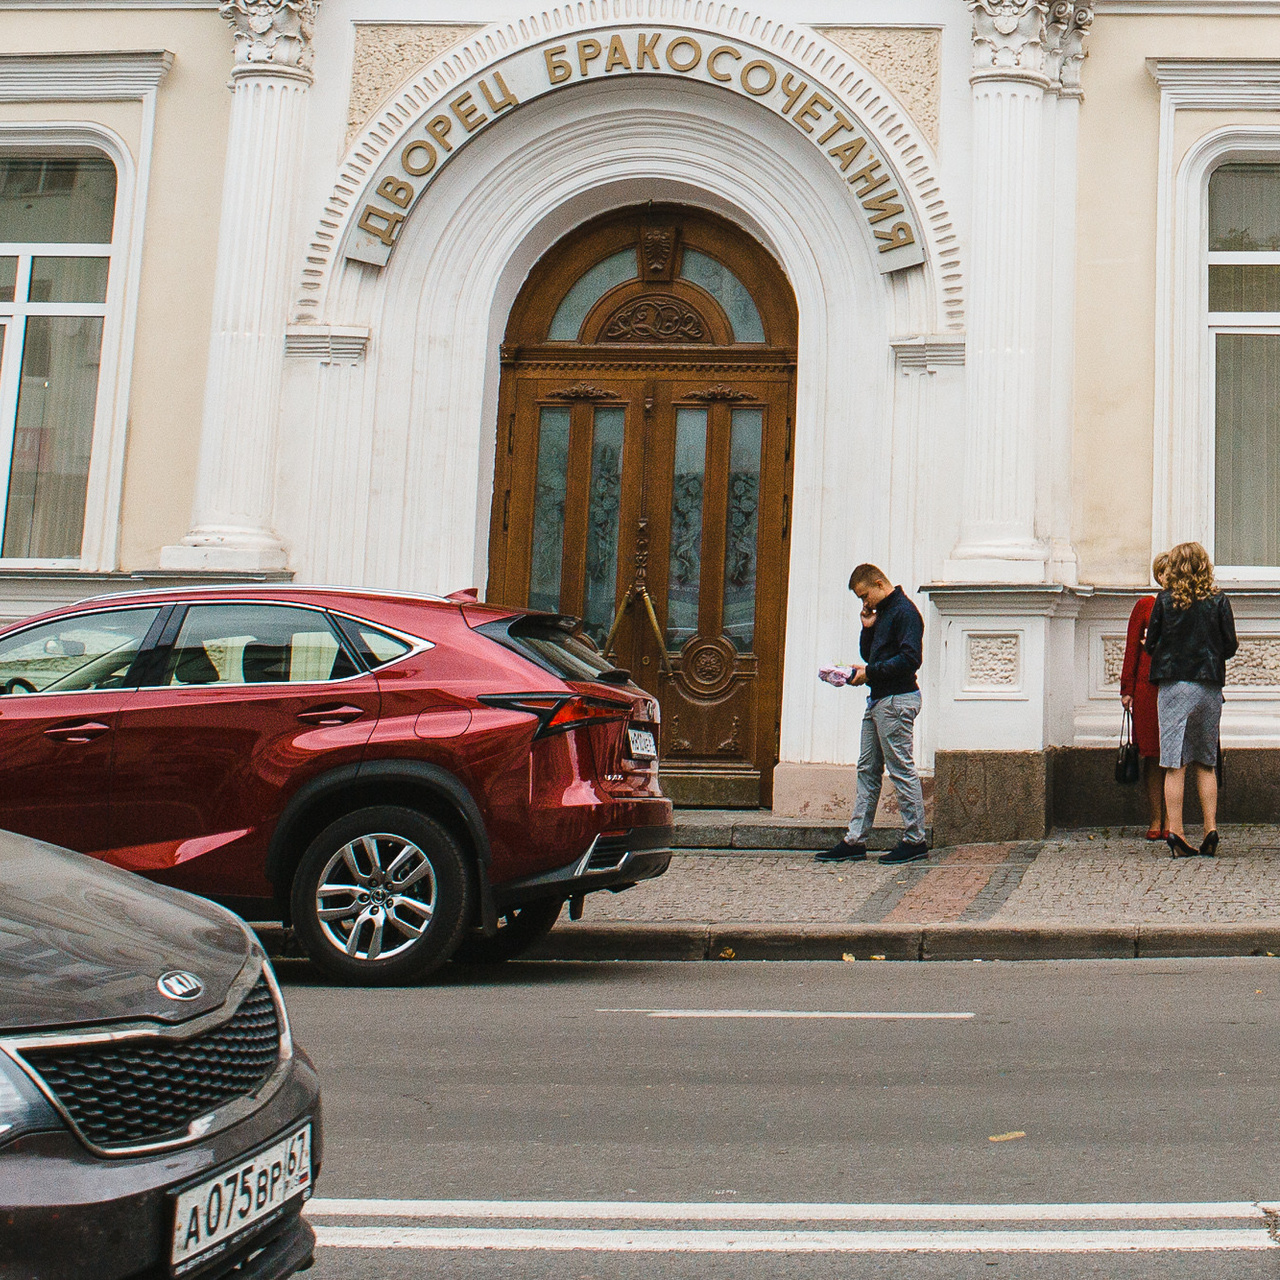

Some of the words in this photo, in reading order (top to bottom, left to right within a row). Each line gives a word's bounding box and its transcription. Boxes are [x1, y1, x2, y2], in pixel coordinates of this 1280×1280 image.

[357, 70, 519, 246] ДВОРЕЦ
[544, 32, 915, 253] БРАКОСОЧЕТАНИЯ
[163, 974, 202, 995] KIA
[287, 1131, 306, 1176] 67
